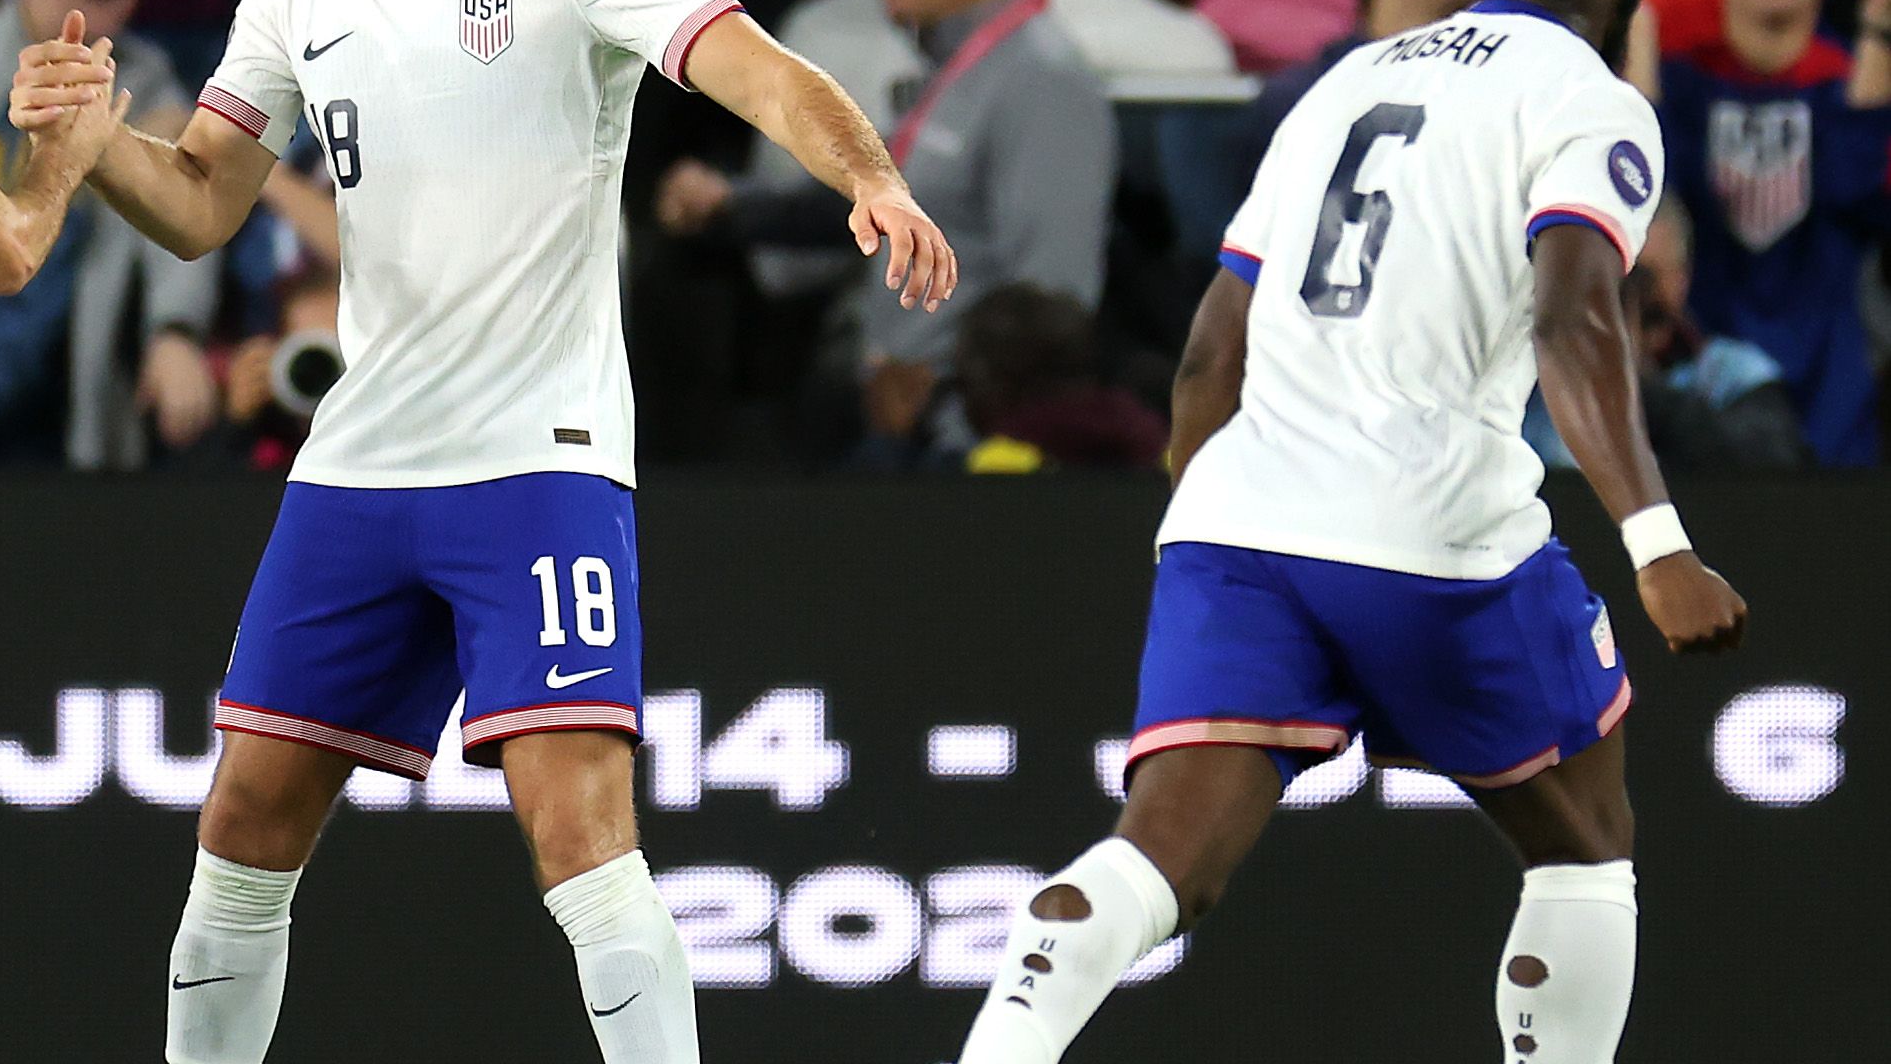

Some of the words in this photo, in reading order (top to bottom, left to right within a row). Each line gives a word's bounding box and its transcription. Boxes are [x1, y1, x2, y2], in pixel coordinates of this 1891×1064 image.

[1372, 26, 1511, 69] MUSAH
[1299, 102, 1426, 318] 6
[530, 555, 617, 648] 18
[1713, 685, 1848, 808] 6
